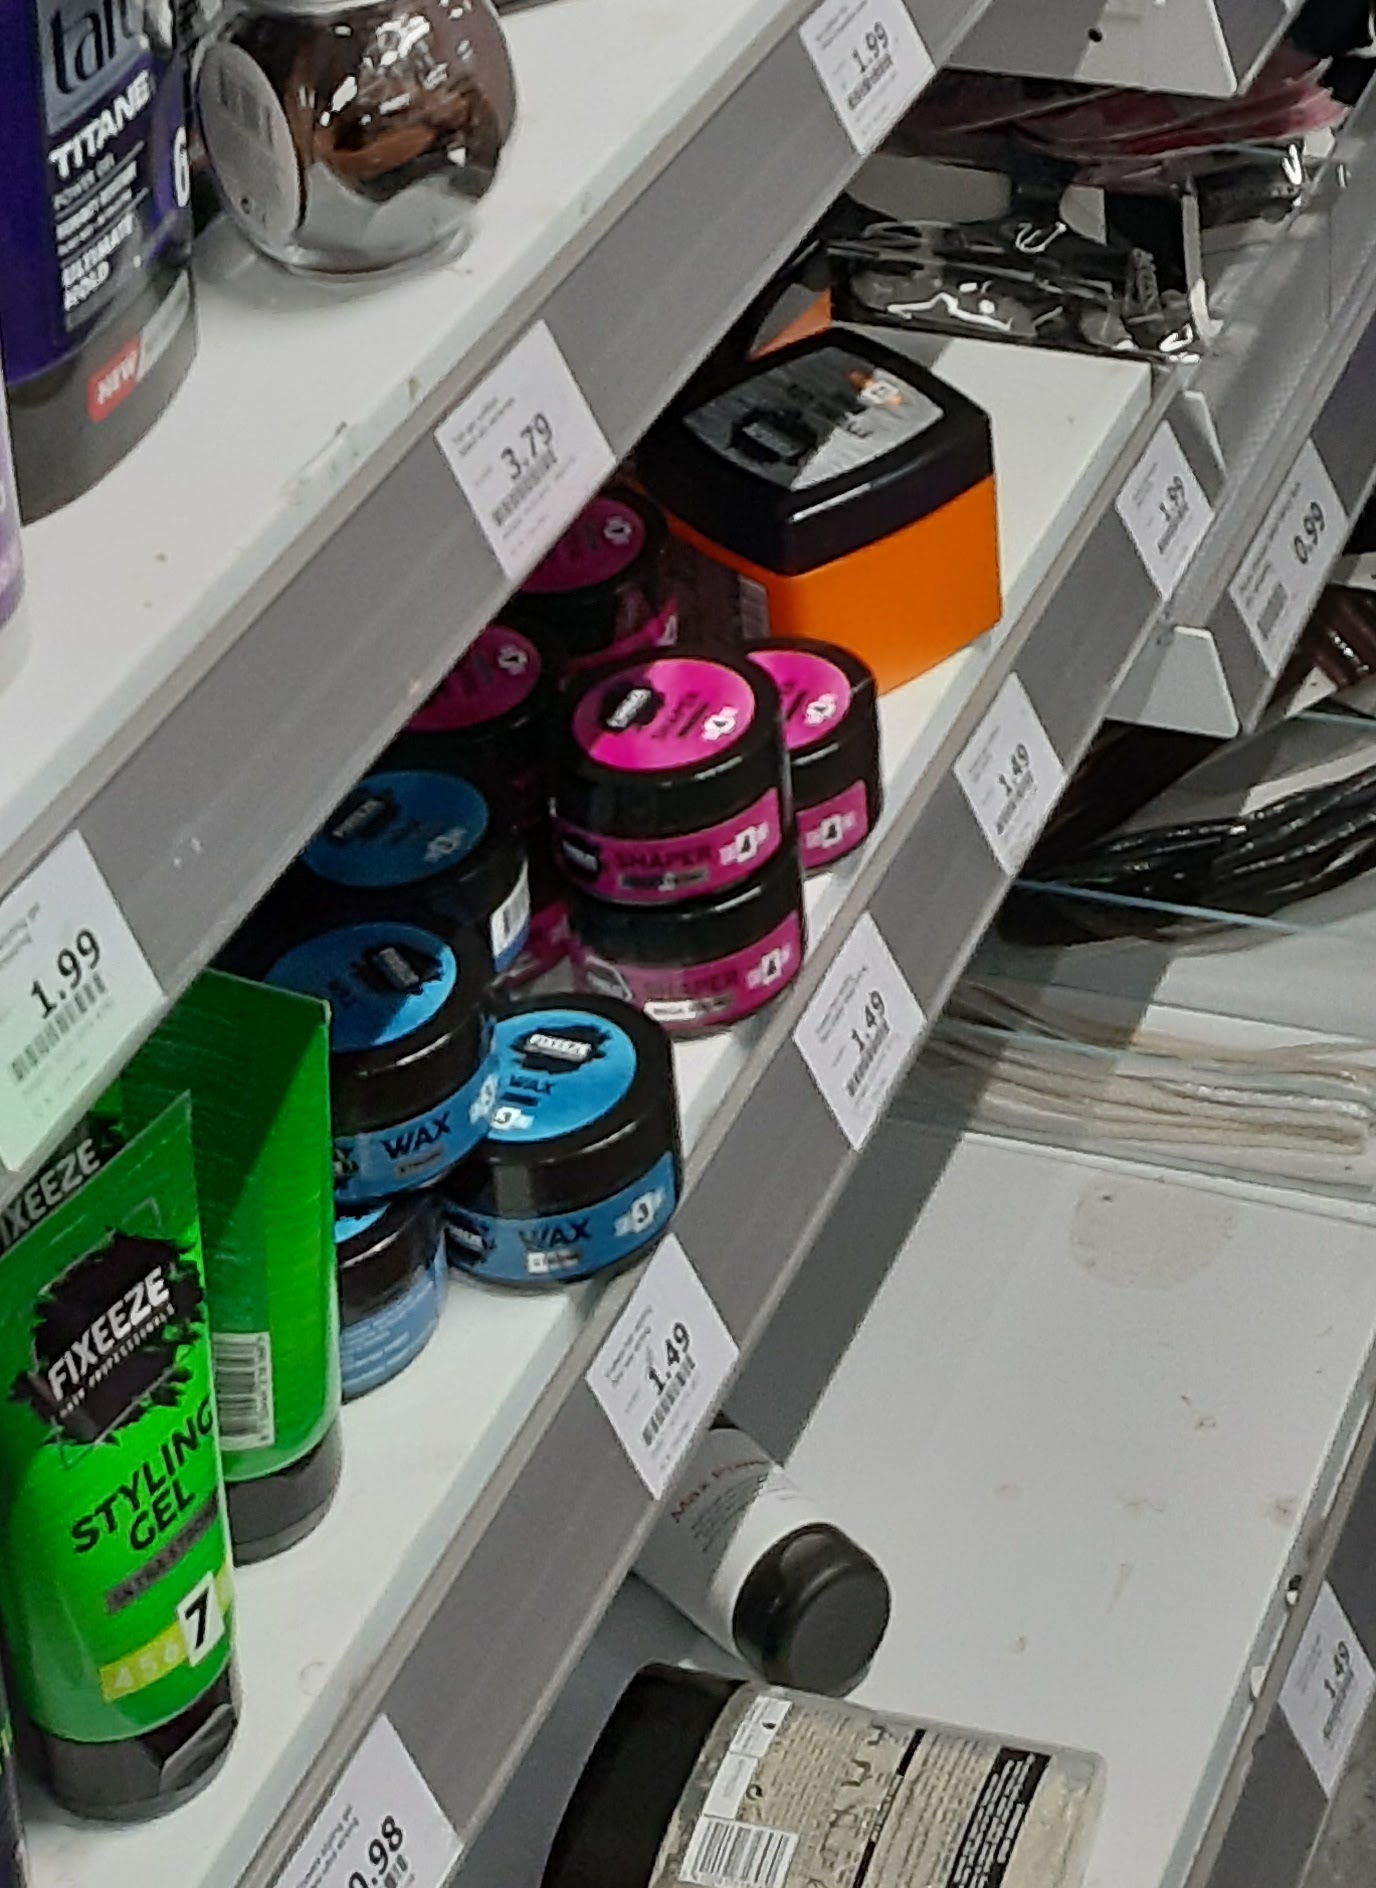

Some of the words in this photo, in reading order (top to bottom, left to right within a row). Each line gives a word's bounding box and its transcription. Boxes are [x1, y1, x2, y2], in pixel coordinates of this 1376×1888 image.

[851, 20, 889, 74] 1.99
[173, 126, 191, 208] 6
[500, 412, 554, 480] 3.79
[1158, 474, 1187, 525] 1.99
[1293, 501, 1327, 566] 0.99
[998, 742, 1032, 795] 1.49
[615, 844, 713, 870] SHAPER
[29, 928, 104, 1018] 1.99
[849, 989, 890, 1053] 1.49
[510, 1073, 556, 1096] WAX
[381, 1112, 451, 1160] WAX
[518, 1218, 591, 1251] WAX
[47, 1265, 171, 1403] FIXEEZE
[648, 1320, 691, 1394] 1.49
[70, 1398, 216, 1555] STYLING
[128, 1478, 195, 1552] GEL
[184, 1585, 210, 1651] 7
[1322, 1637, 1354, 1701] 1.49
[351, 1814, 406, 1888] 0.98
